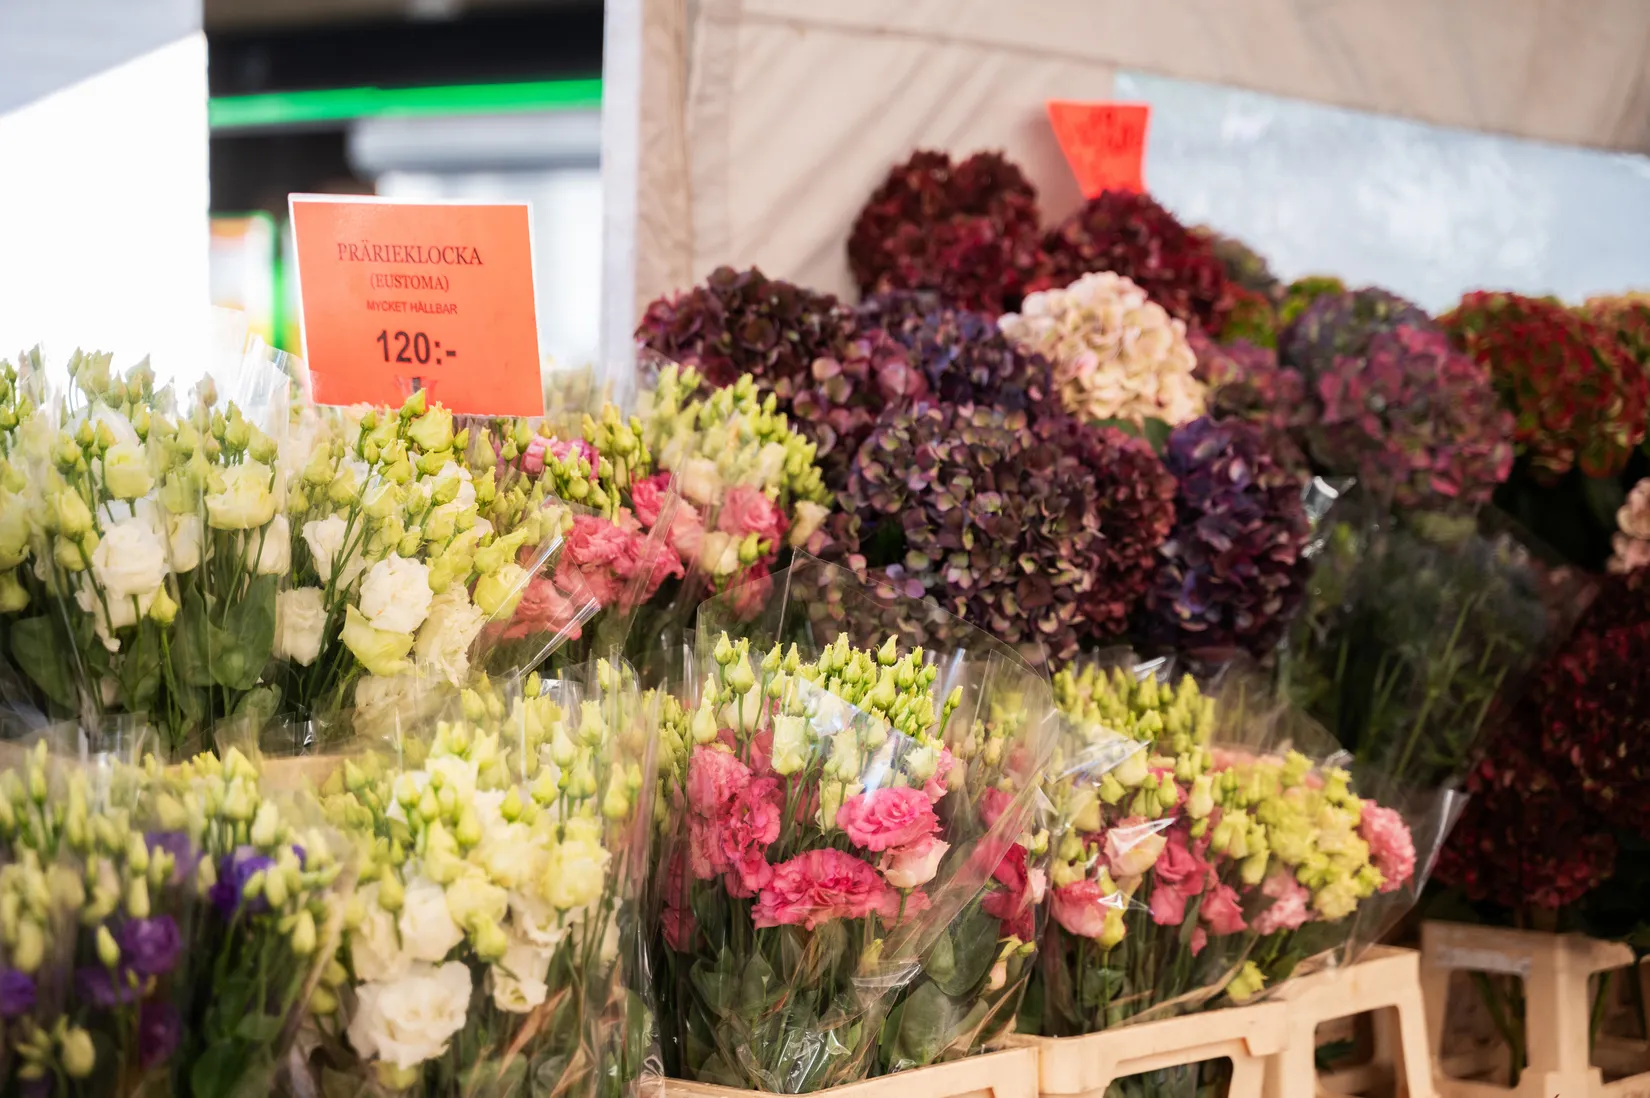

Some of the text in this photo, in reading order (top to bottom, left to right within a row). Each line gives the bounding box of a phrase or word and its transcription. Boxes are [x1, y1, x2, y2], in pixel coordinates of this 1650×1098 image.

[337, 240, 483, 265] PRÄRIEKLOCKA
[370, 273, 449, 292] (EUSTOMA)
[366, 300, 407, 313] MYCKET
[377, 330, 457, 365] 120:-
